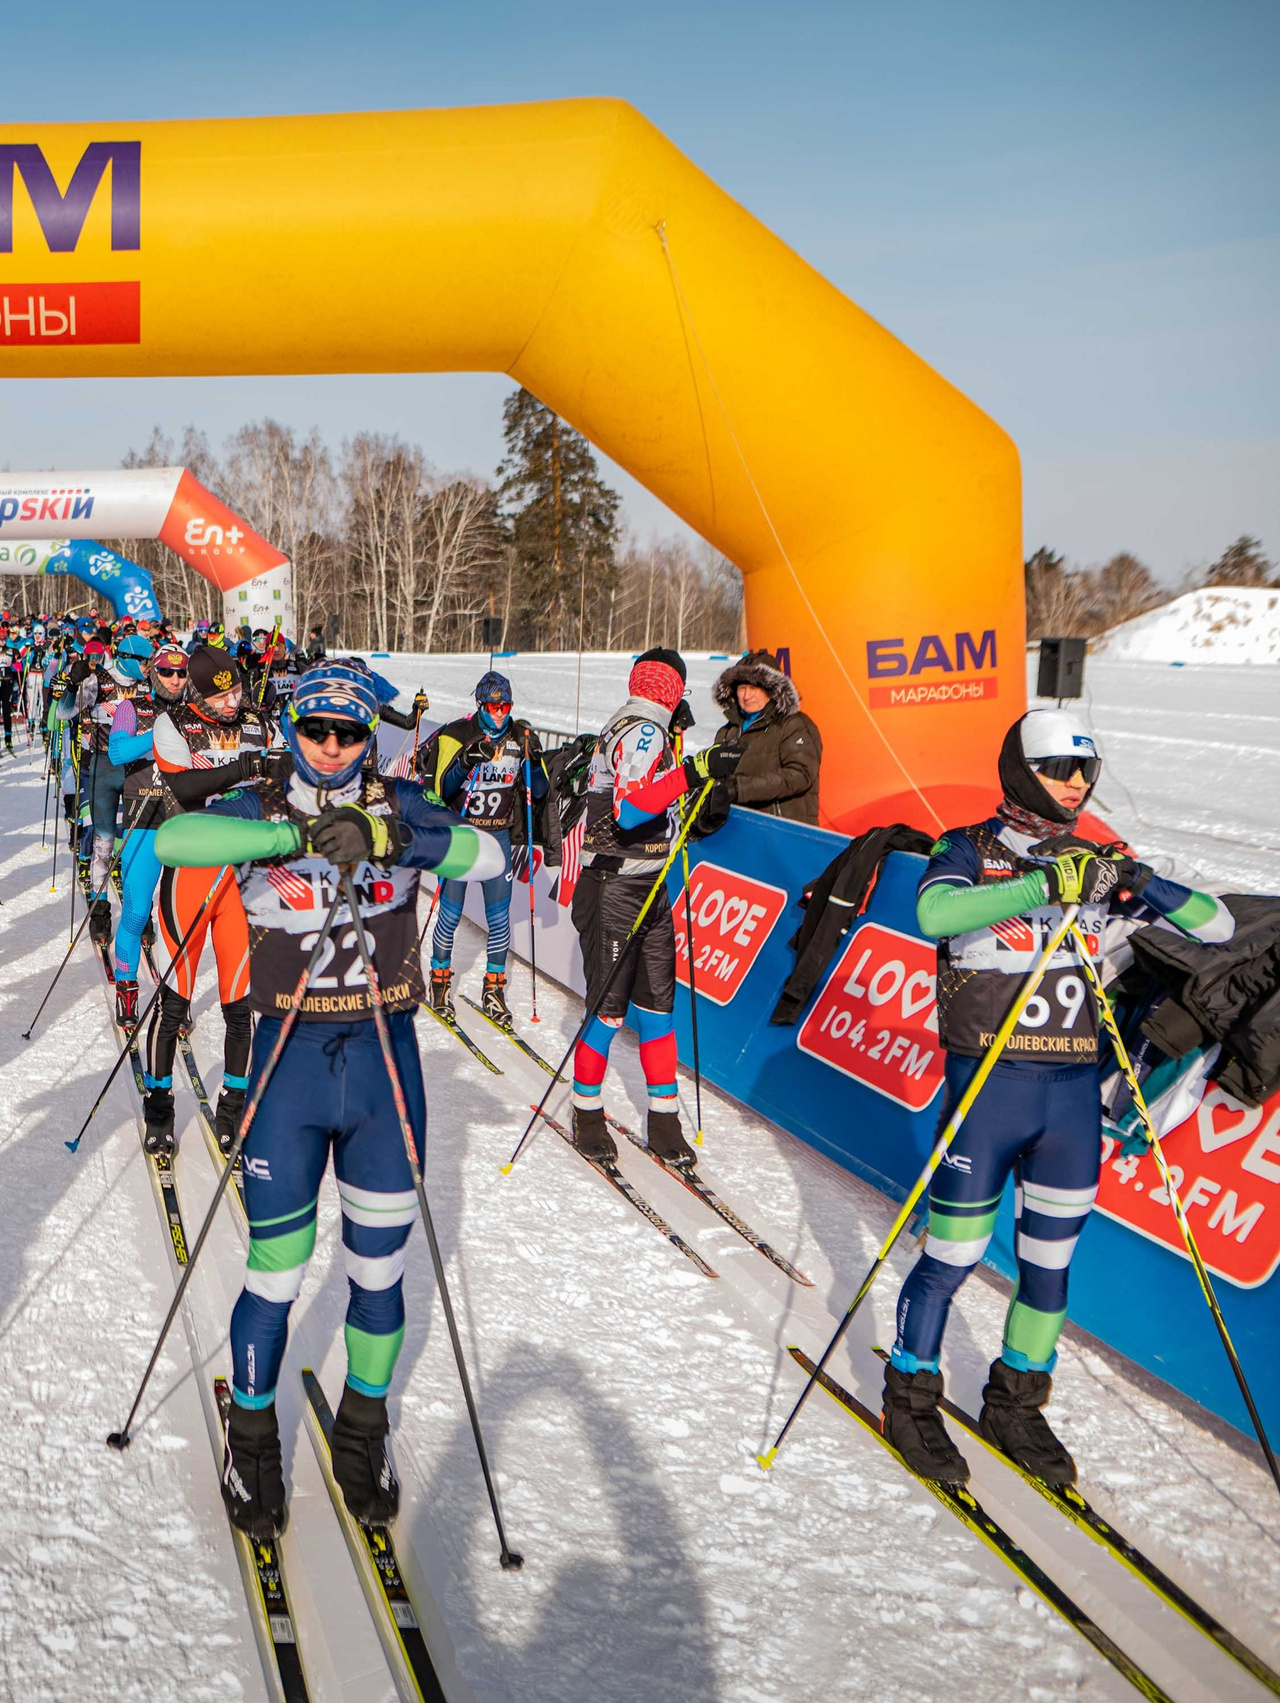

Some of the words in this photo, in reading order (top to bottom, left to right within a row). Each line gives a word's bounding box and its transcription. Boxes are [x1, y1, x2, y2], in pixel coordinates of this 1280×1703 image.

[866, 630, 998, 680] БАМ
[890, 681, 985, 704] МАРАФОНЫ
[482, 773, 513, 785] LAND
[483, 766, 515, 775] KRAS
[469, 792, 502, 818] 39
[320, 866, 393, 885] KAS
[1040, 917, 1102, 934] KAS
[300, 929, 379, 989] 22
[1018, 974, 1086, 1030] 69
[820, 1006, 934, 1081] 104.2FM
[170, 1223, 189, 1264] FISCHER
